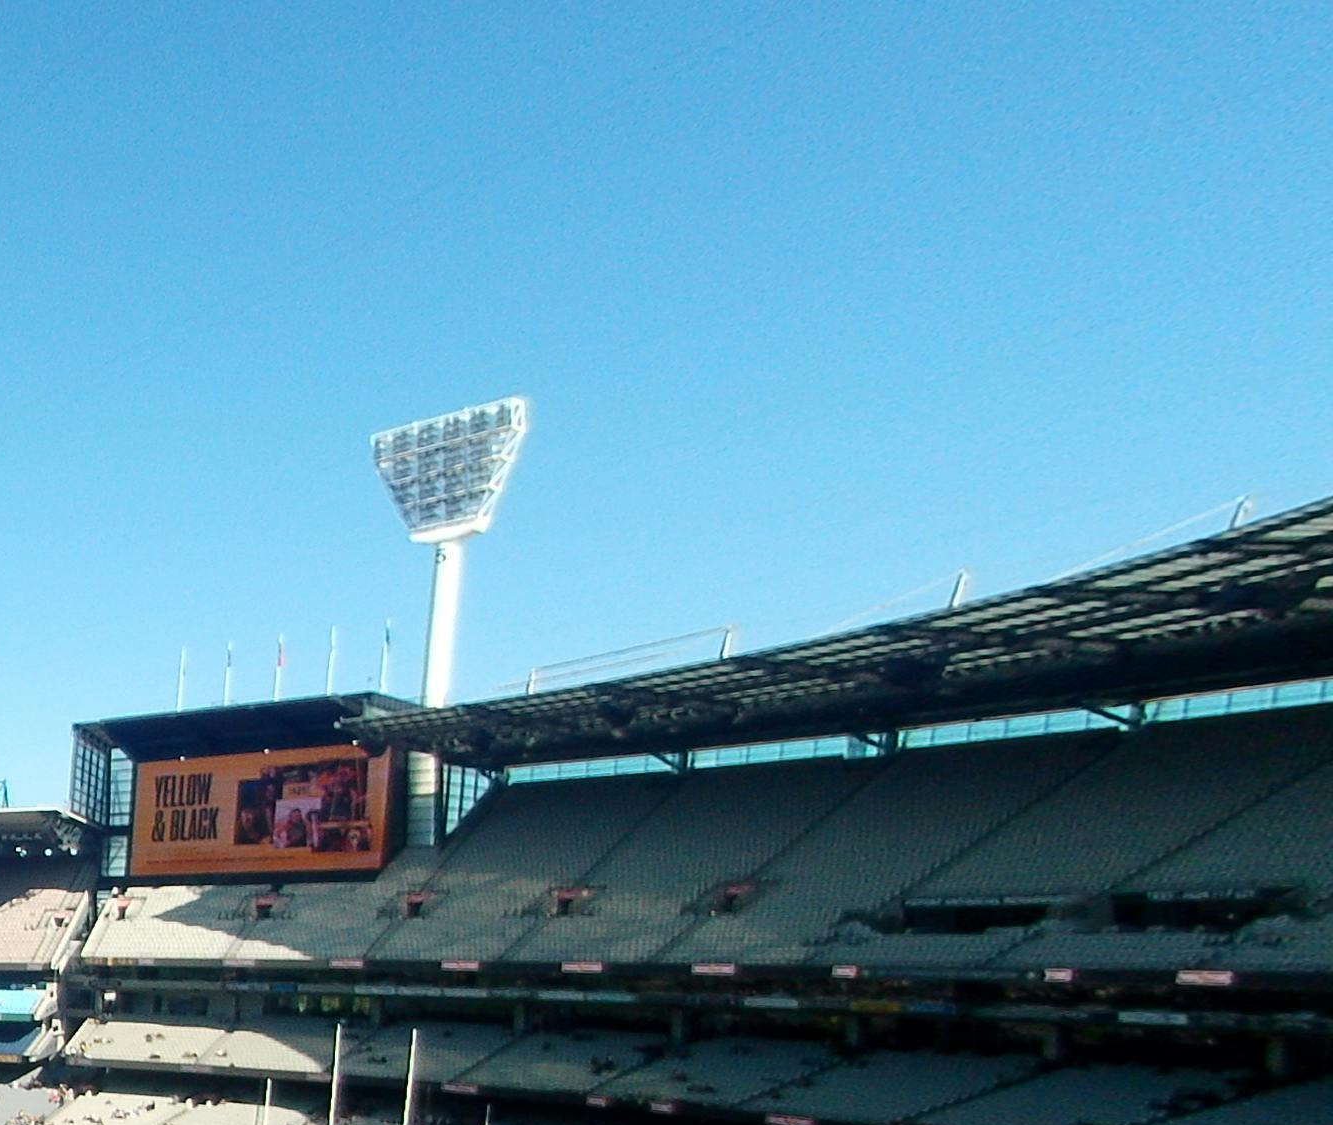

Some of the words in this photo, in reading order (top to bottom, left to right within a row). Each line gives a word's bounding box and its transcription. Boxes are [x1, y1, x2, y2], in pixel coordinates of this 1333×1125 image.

[155, 773, 212, 807] YELLOW
[151, 810, 165, 842] &
[170, 808, 219, 841] BLACK
